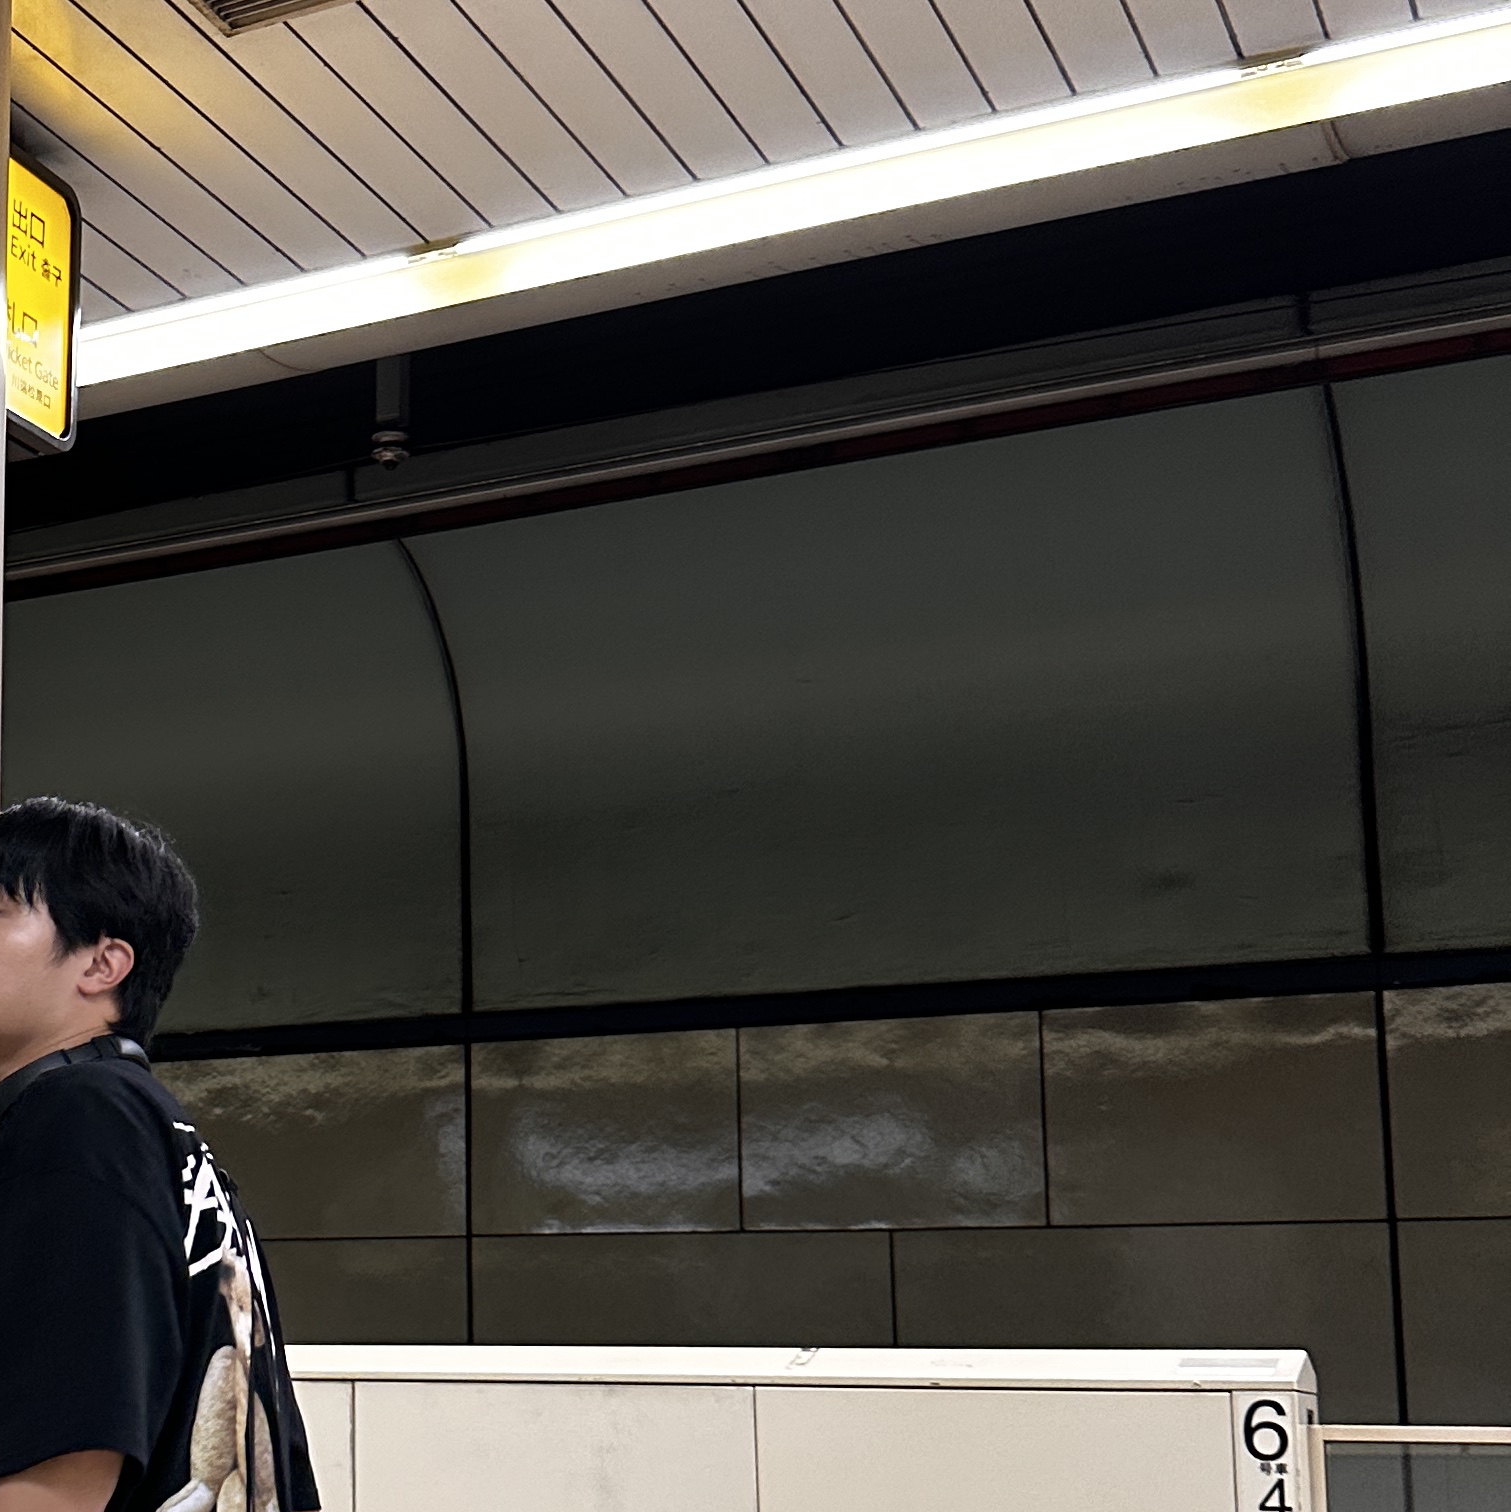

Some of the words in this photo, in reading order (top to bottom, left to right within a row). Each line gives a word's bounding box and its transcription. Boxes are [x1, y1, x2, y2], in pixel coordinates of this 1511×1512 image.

[12, 198, 45, 249] 出口
[11, 234, 36, 272] Exit
[35, 361, 59, 391] Gate
[1244, 1399, 1289, 1461] 6
